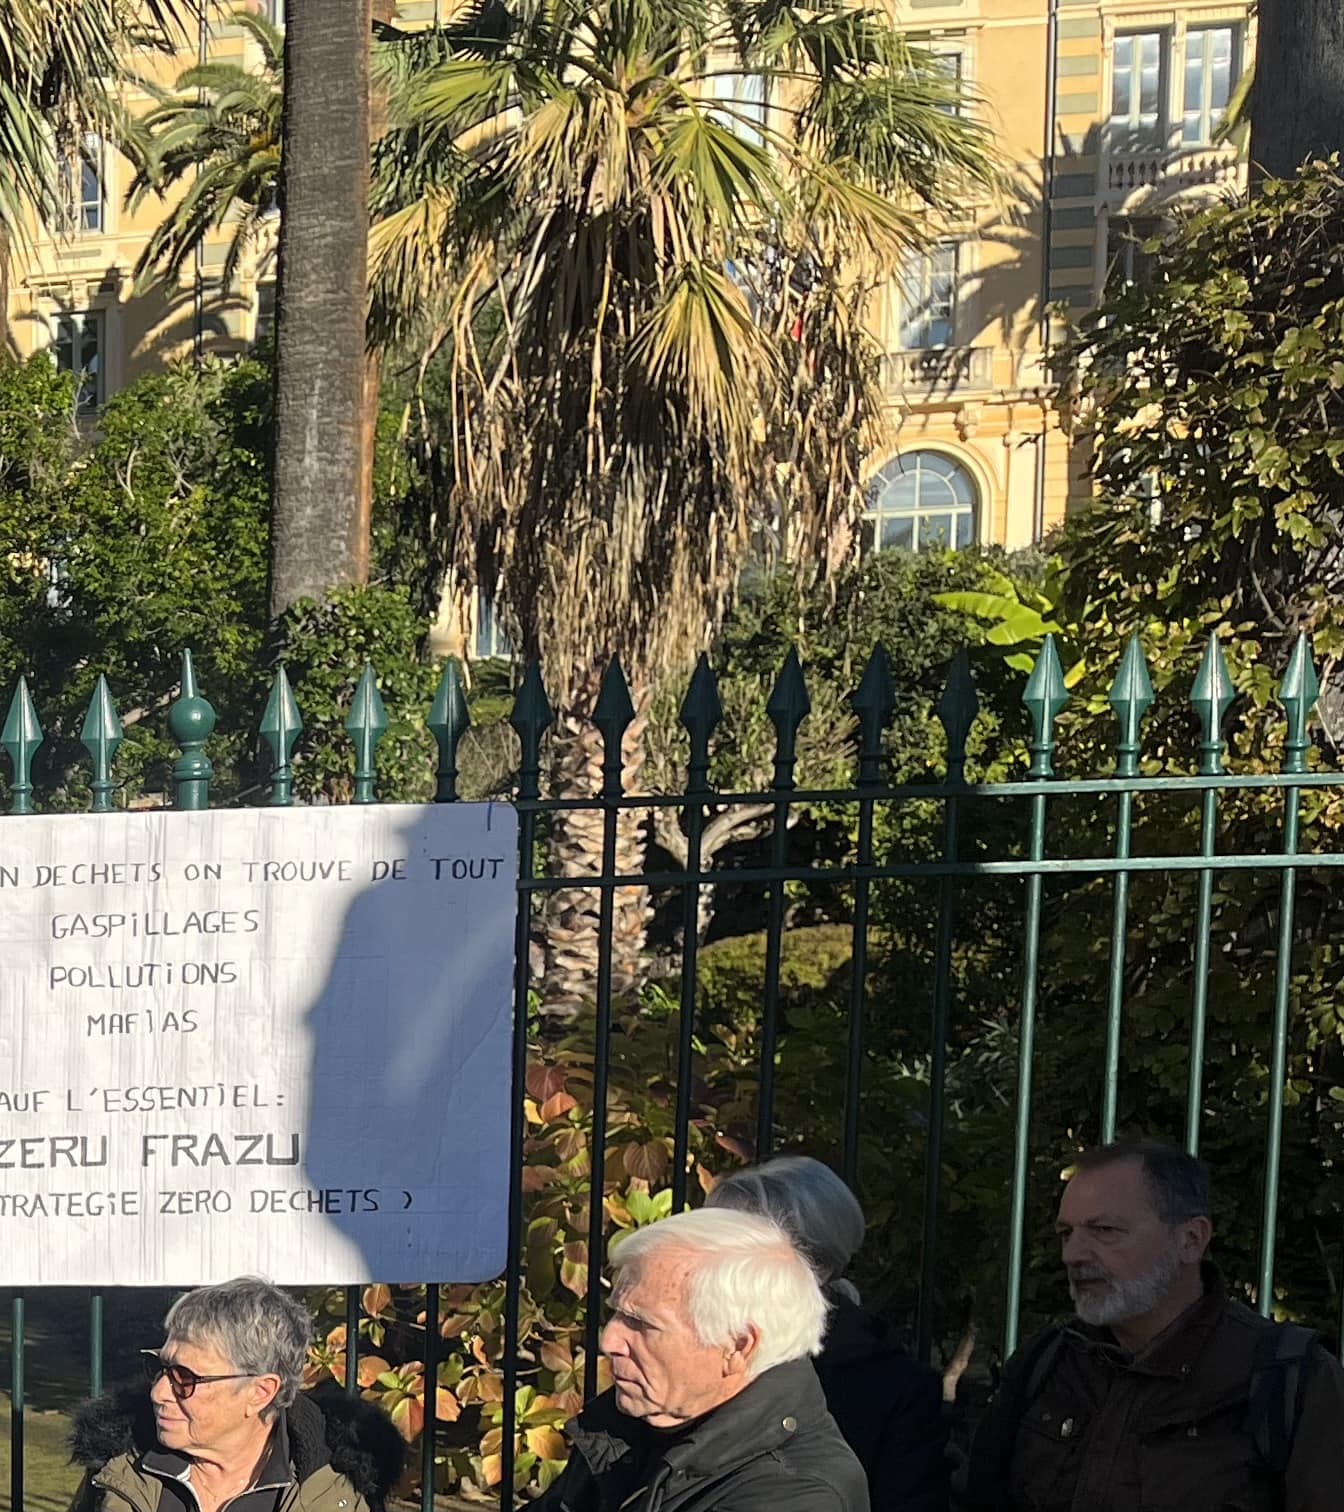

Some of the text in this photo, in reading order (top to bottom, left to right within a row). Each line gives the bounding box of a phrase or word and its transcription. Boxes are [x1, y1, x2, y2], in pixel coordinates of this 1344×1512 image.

[32, 861, 162, 888] DECHETS
[184, 862, 222, 882] ON
[242, 859, 353, 883] TROUVE
[371, 858, 409, 882] DE
[429, 857, 505, 881] TOUT
[51, 909, 259, 941] GASPILLAGES
[50, 961, 238, 991] POLLUTIONS
[87, 1009, 199, 1037] MAFIAS
[141, 1132, 300, 1168] FRAZU
[158, 1189, 232, 1215] ZERO
[249, 1188, 381, 1214] DECHETS
